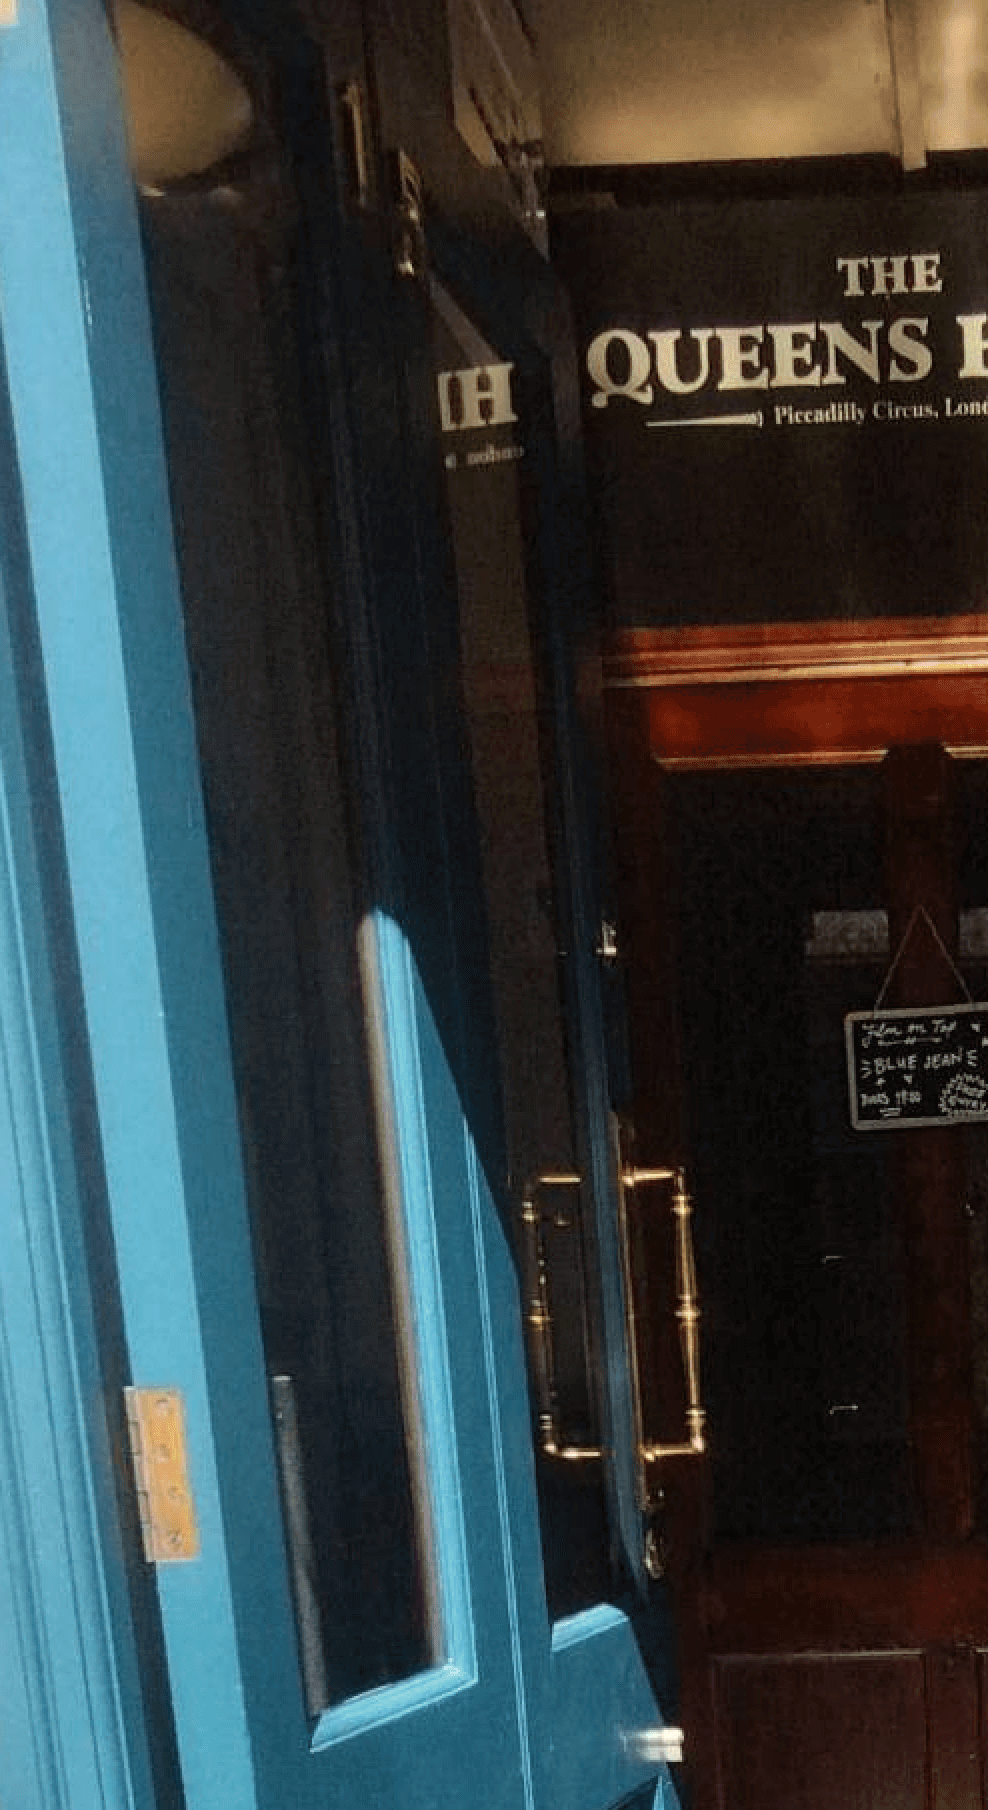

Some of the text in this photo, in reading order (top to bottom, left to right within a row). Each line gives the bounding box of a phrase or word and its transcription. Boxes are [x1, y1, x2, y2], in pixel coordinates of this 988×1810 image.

[836, 252, 943, 298] THE
[586, 316, 931, 408] QUEENS
[773, 400, 865, 425] Piccadilly
[873, 400, 939, 419] Circus,
[873, 1054, 918, 1075] BLUE
